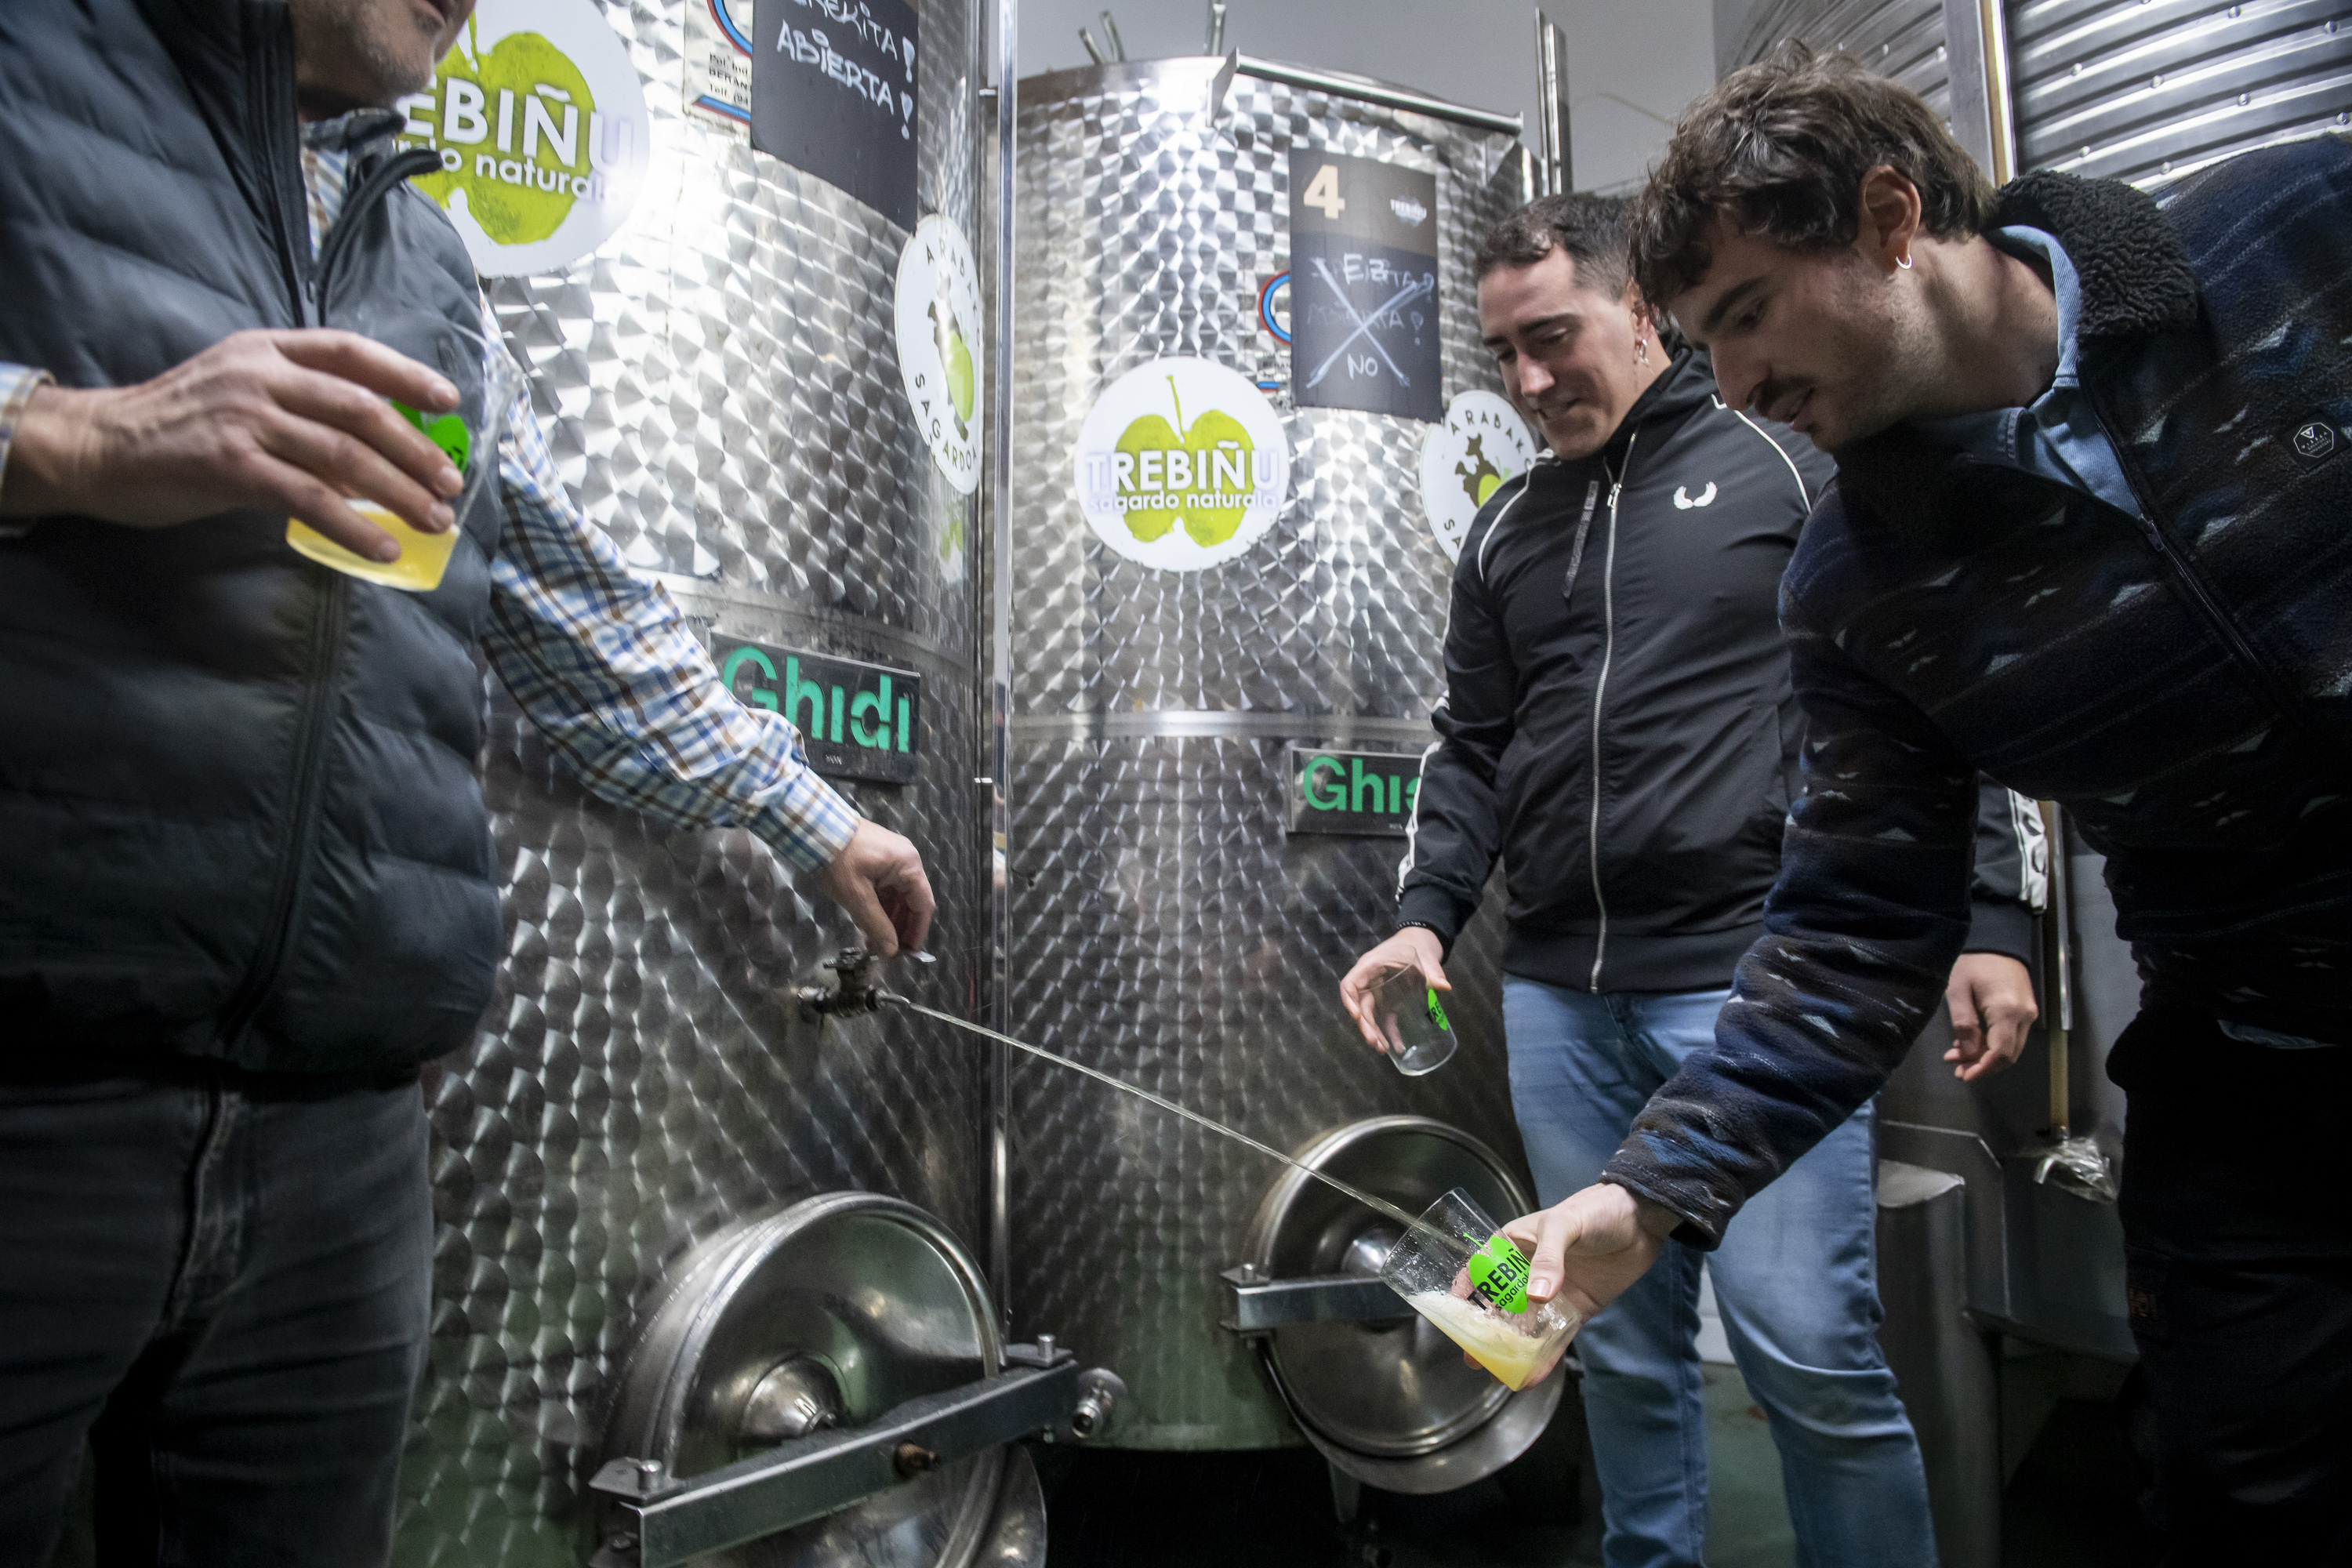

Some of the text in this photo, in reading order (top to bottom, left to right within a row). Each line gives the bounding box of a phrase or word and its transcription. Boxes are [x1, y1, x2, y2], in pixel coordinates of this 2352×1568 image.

[709, 68, 751, 92] BERAN
[396, 75, 633, 169] EBIÑU
[1303, 164, 1345, 220] 4
[1347, 353, 1378, 380] NO
[1086, 440, 1279, 492] TREBIÑU
[1089, 488, 1277, 515] sagardo naturala
[1303, 755, 1421, 813] Ghi
[1466, 1247, 1531, 1311] TREBIÑ
